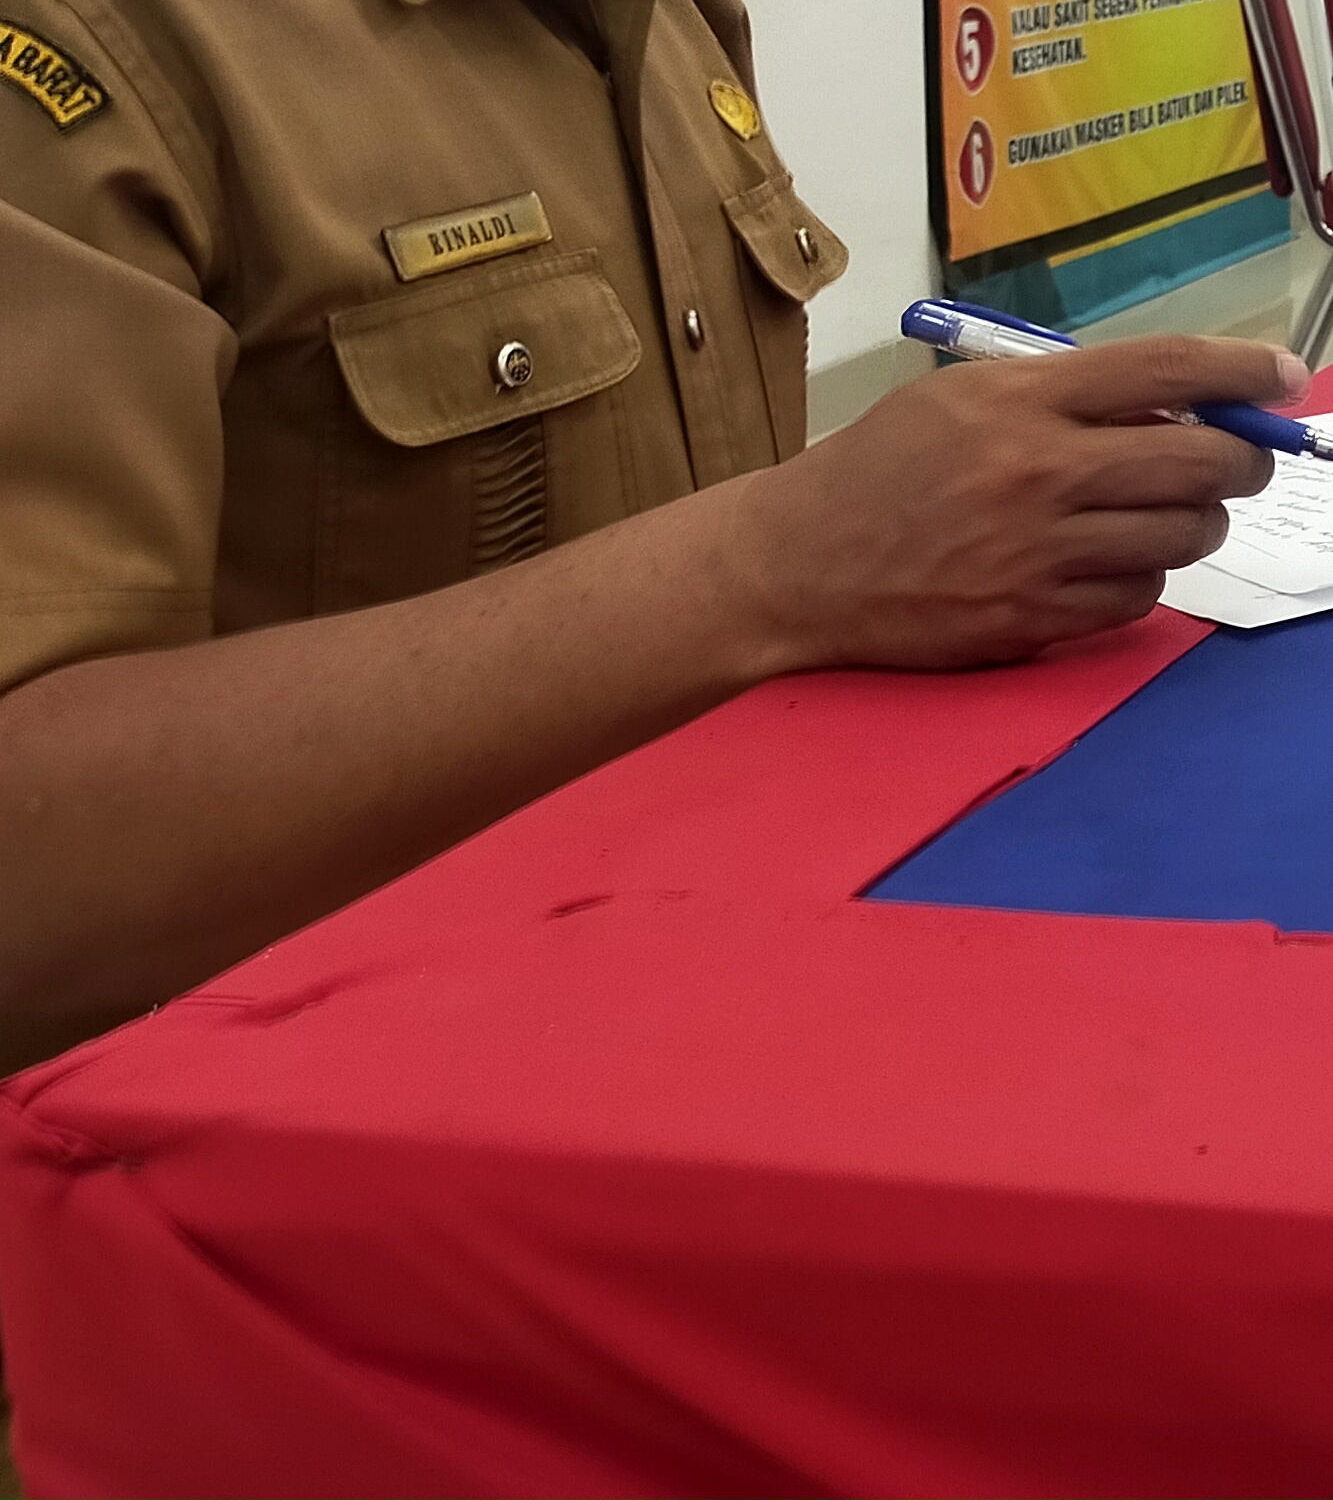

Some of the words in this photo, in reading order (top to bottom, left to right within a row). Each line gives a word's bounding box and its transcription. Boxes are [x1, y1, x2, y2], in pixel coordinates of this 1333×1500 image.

[1011, 5, 1050, 37] KALAU
[1054, 0, 1090, 29] SAKIT
[12, 45, 96, 113] BARAT
[961, 20, 982, 82] 5
[1012, 37, 1088, 76] KESEHATAN.
[1008, 127, 1074, 165] GUNAKAN
[1076, 113, 1126, 149] MASKER
[1129, 107, 1154, 133] BILA
[1157, 98, 1192, 128] BATUK
[1194, 93, 1214, 117] DAN
[971, 132, 985, 195] 6
[427, 213, 517, 256] RINALDI
